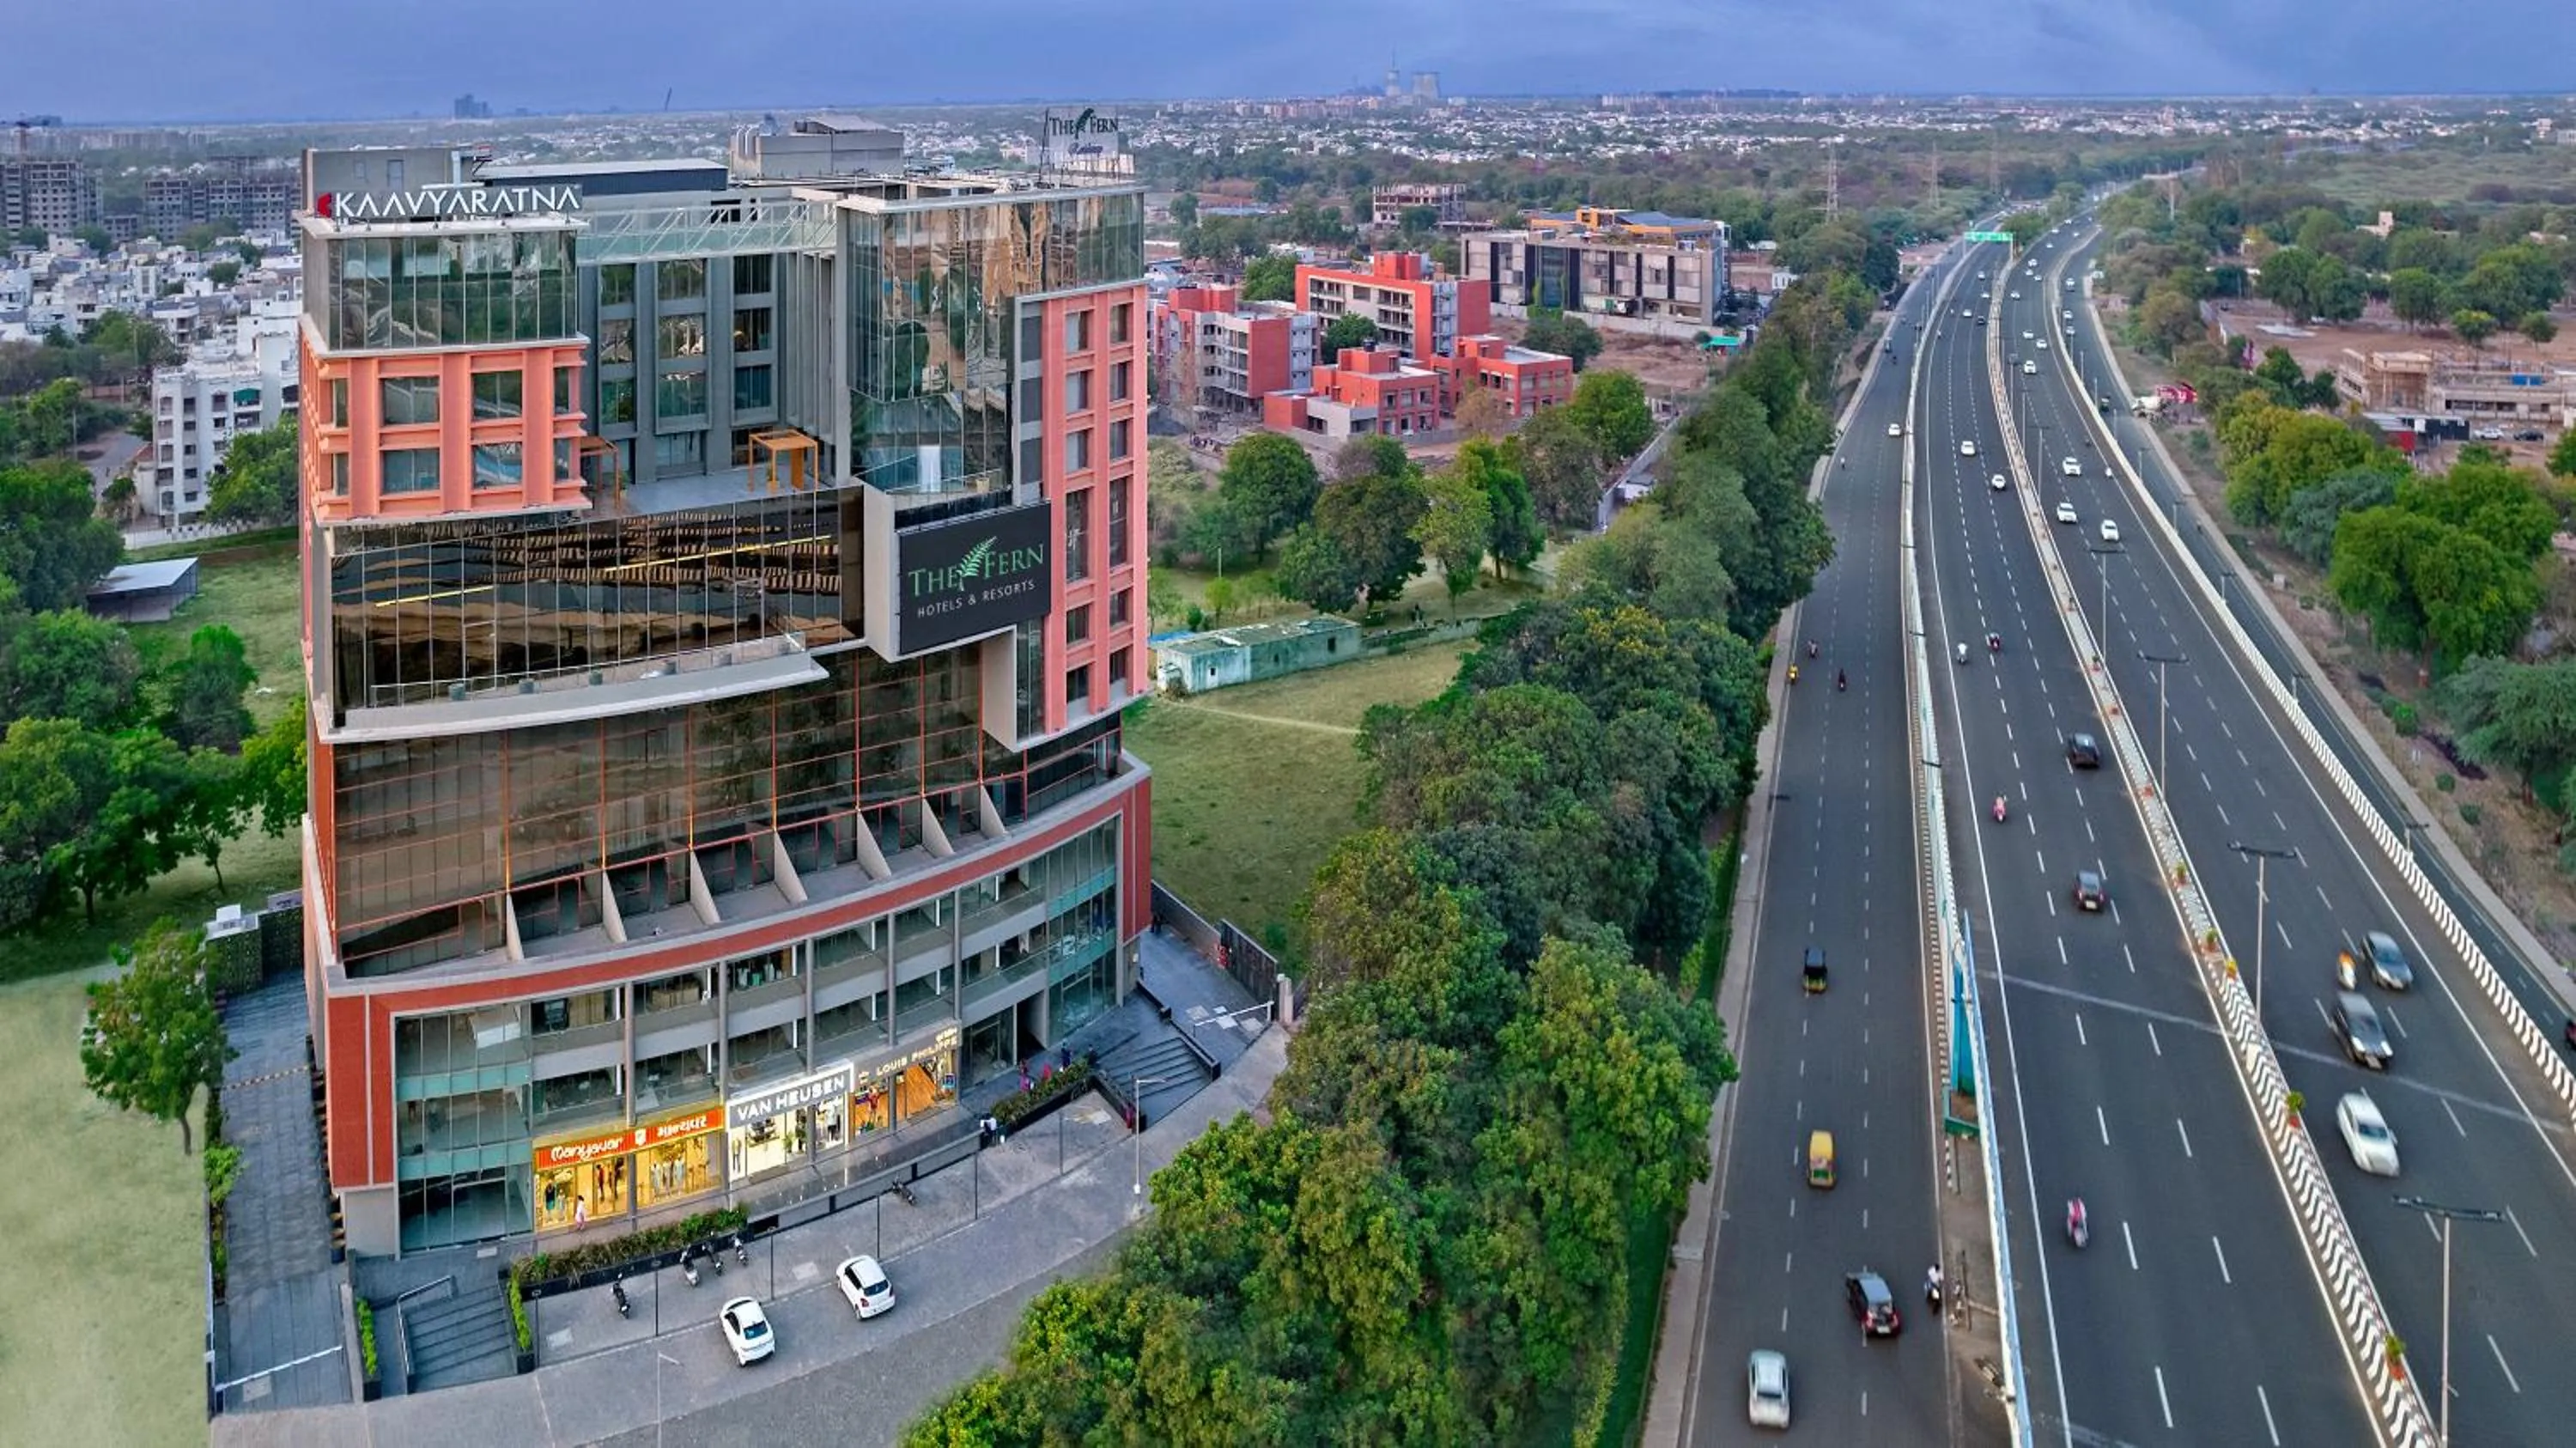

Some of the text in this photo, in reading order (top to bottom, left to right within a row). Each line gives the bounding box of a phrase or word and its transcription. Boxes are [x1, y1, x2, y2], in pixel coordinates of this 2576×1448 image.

[1048, 115, 1118, 136] THE FERN
[335, 186, 580, 217] KAAVYARATNA
[908, 544, 1044, 597] THE FERN
[917, 579, 1036, 618] HOTELS & RESORTS
[876, 1056, 908, 1076] LOUIS
[738, 1074, 845, 1121] VAN HEUSEN
